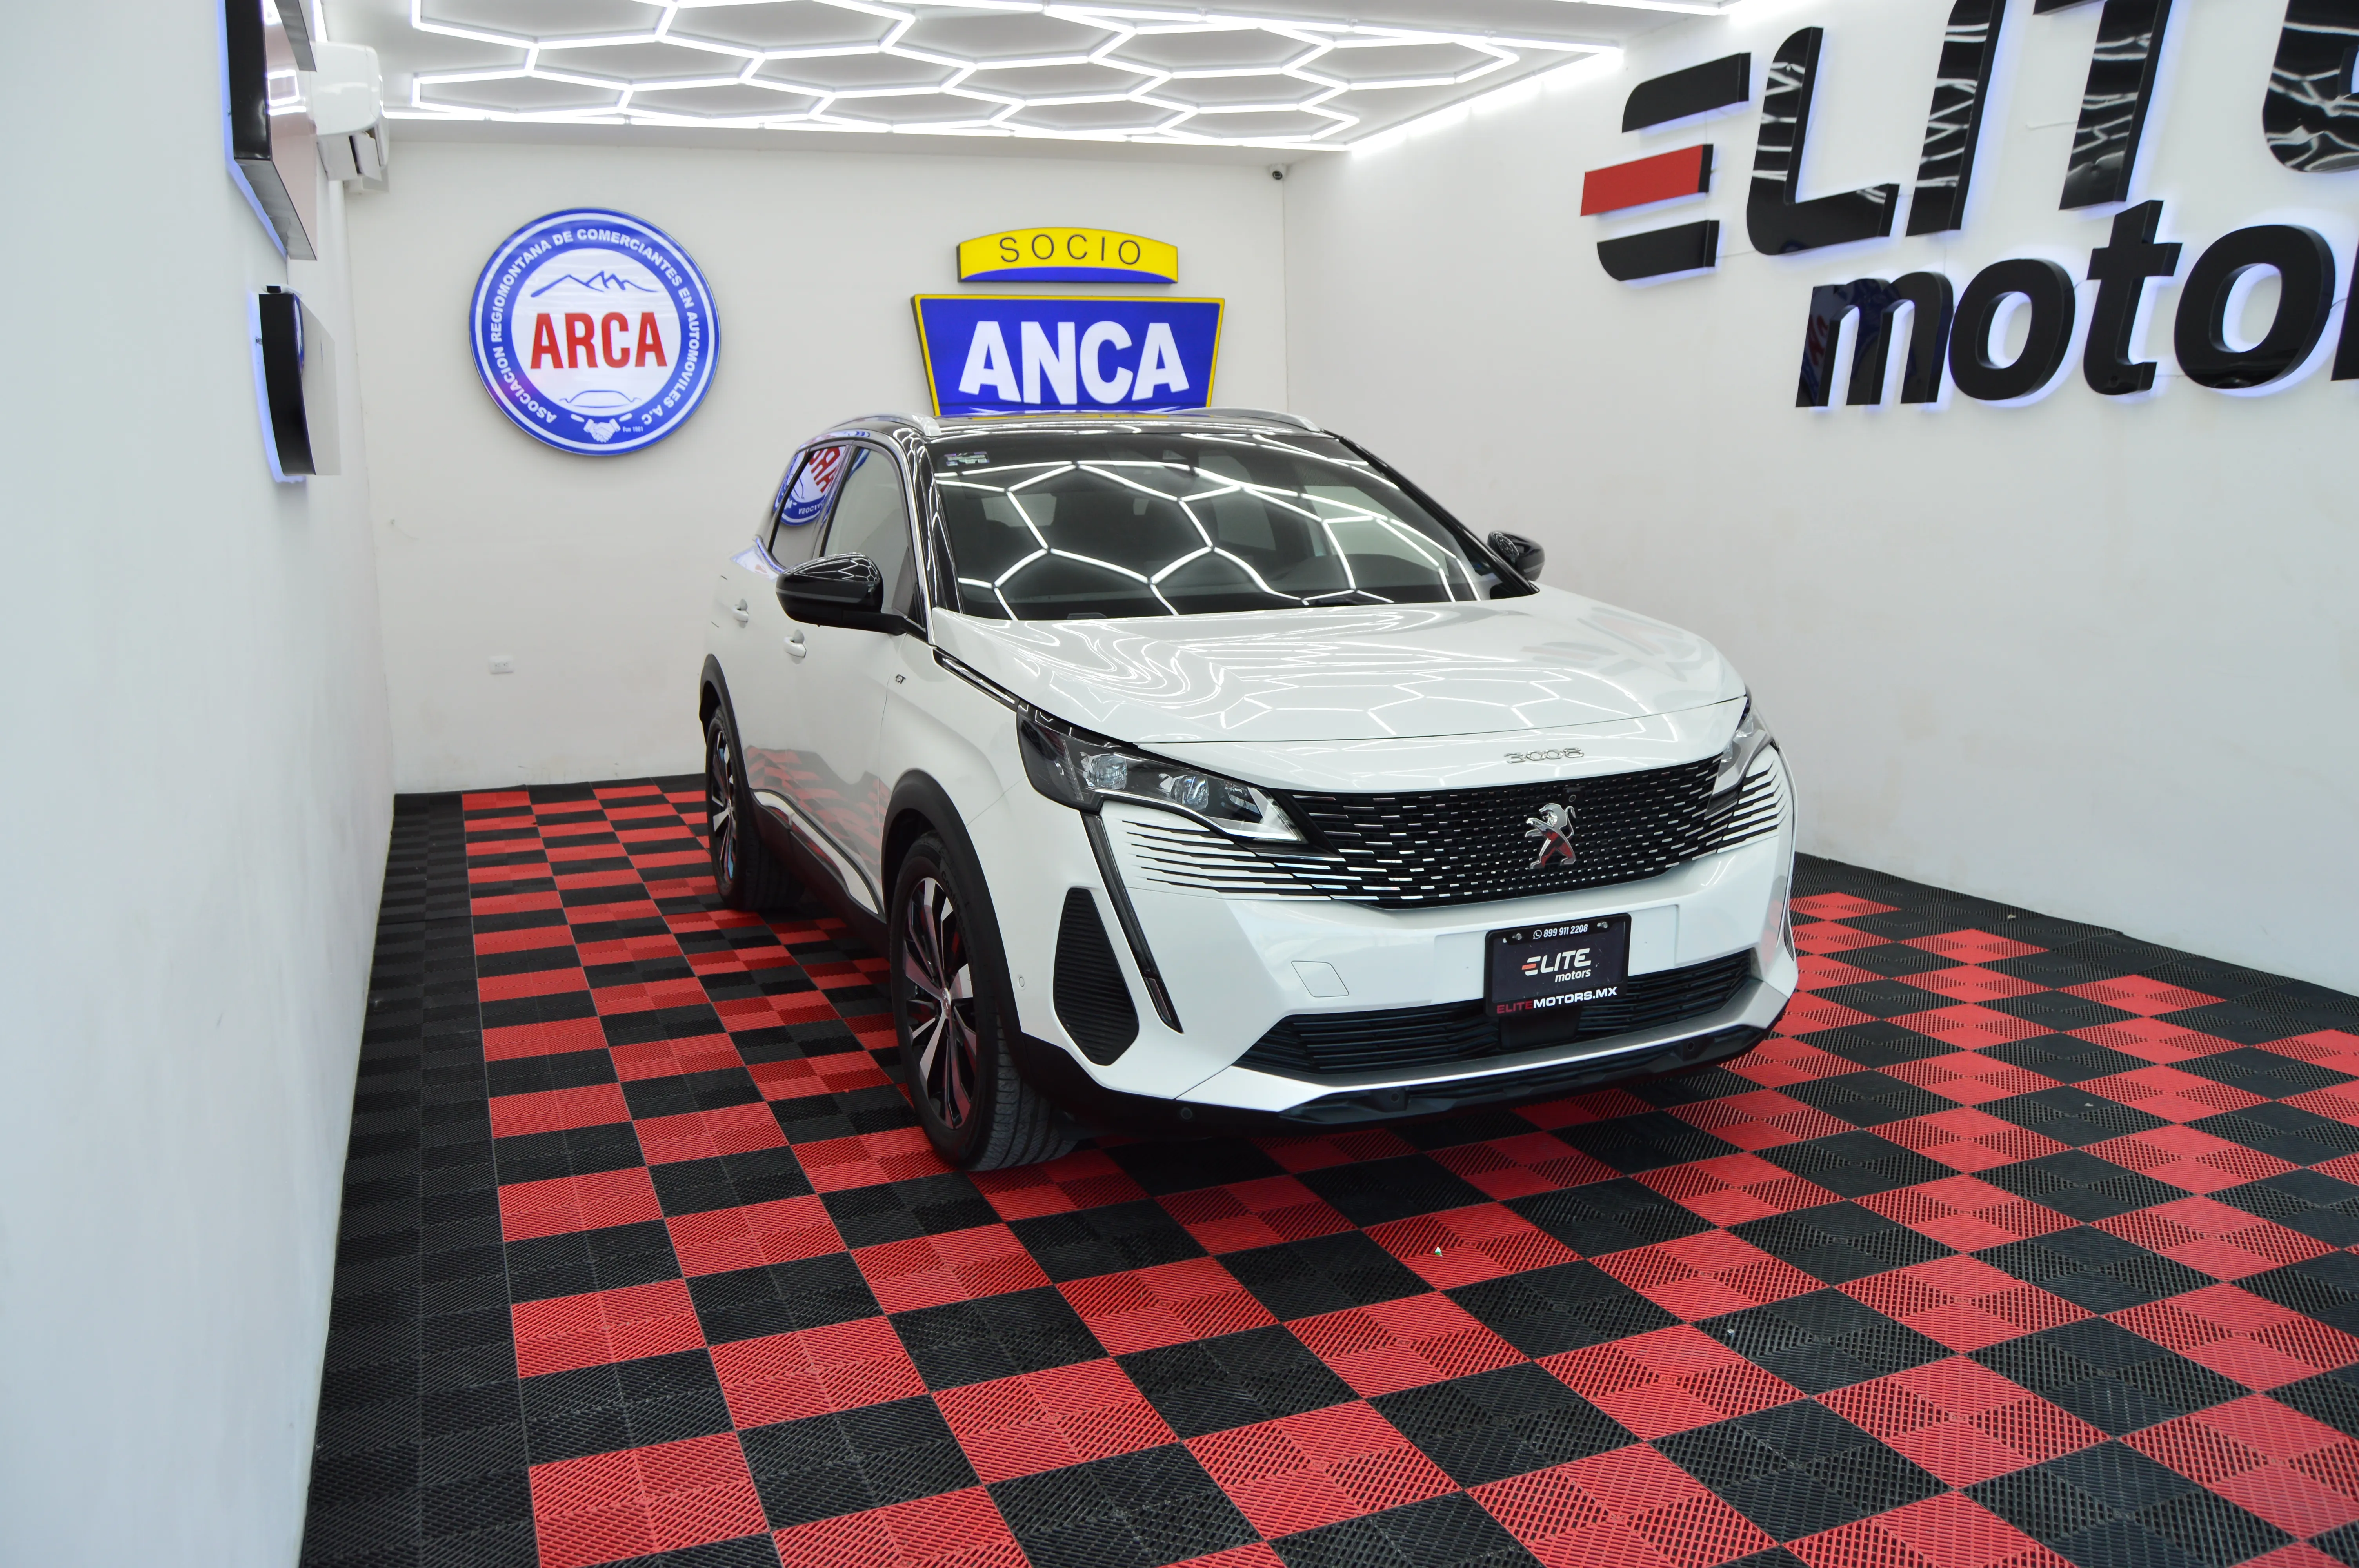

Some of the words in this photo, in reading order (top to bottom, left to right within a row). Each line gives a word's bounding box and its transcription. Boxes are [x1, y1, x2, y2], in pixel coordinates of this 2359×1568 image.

[552, 230, 574, 246] DE
[1000, 234, 1141, 265] SOCIO
[576, 229, 682, 286] COMERCIANTES
[491, 240, 552, 342] REGIOMONTANA
[678, 287, 694, 309] EN
[1795, 200, 2359, 408] moto
[531, 312, 667, 369] ARCA
[663, 312, 700, 408] AUTOMOVILES
[958, 320, 1189, 404] ANCA
[493, 346, 557, 423] ASOCIACION
[1504, 747, 1584, 764] 3008
[1543, 928, 1558, 938] 899
[1559, 926, 1569, 936] 911
[1570, 924, 1588, 934] 2208
[1521, 948, 1592, 976] ELITE
[1555, 969, 1591, 983] motors
[1497, 986, 1617, 1014] ELITEMOTORS.MX
